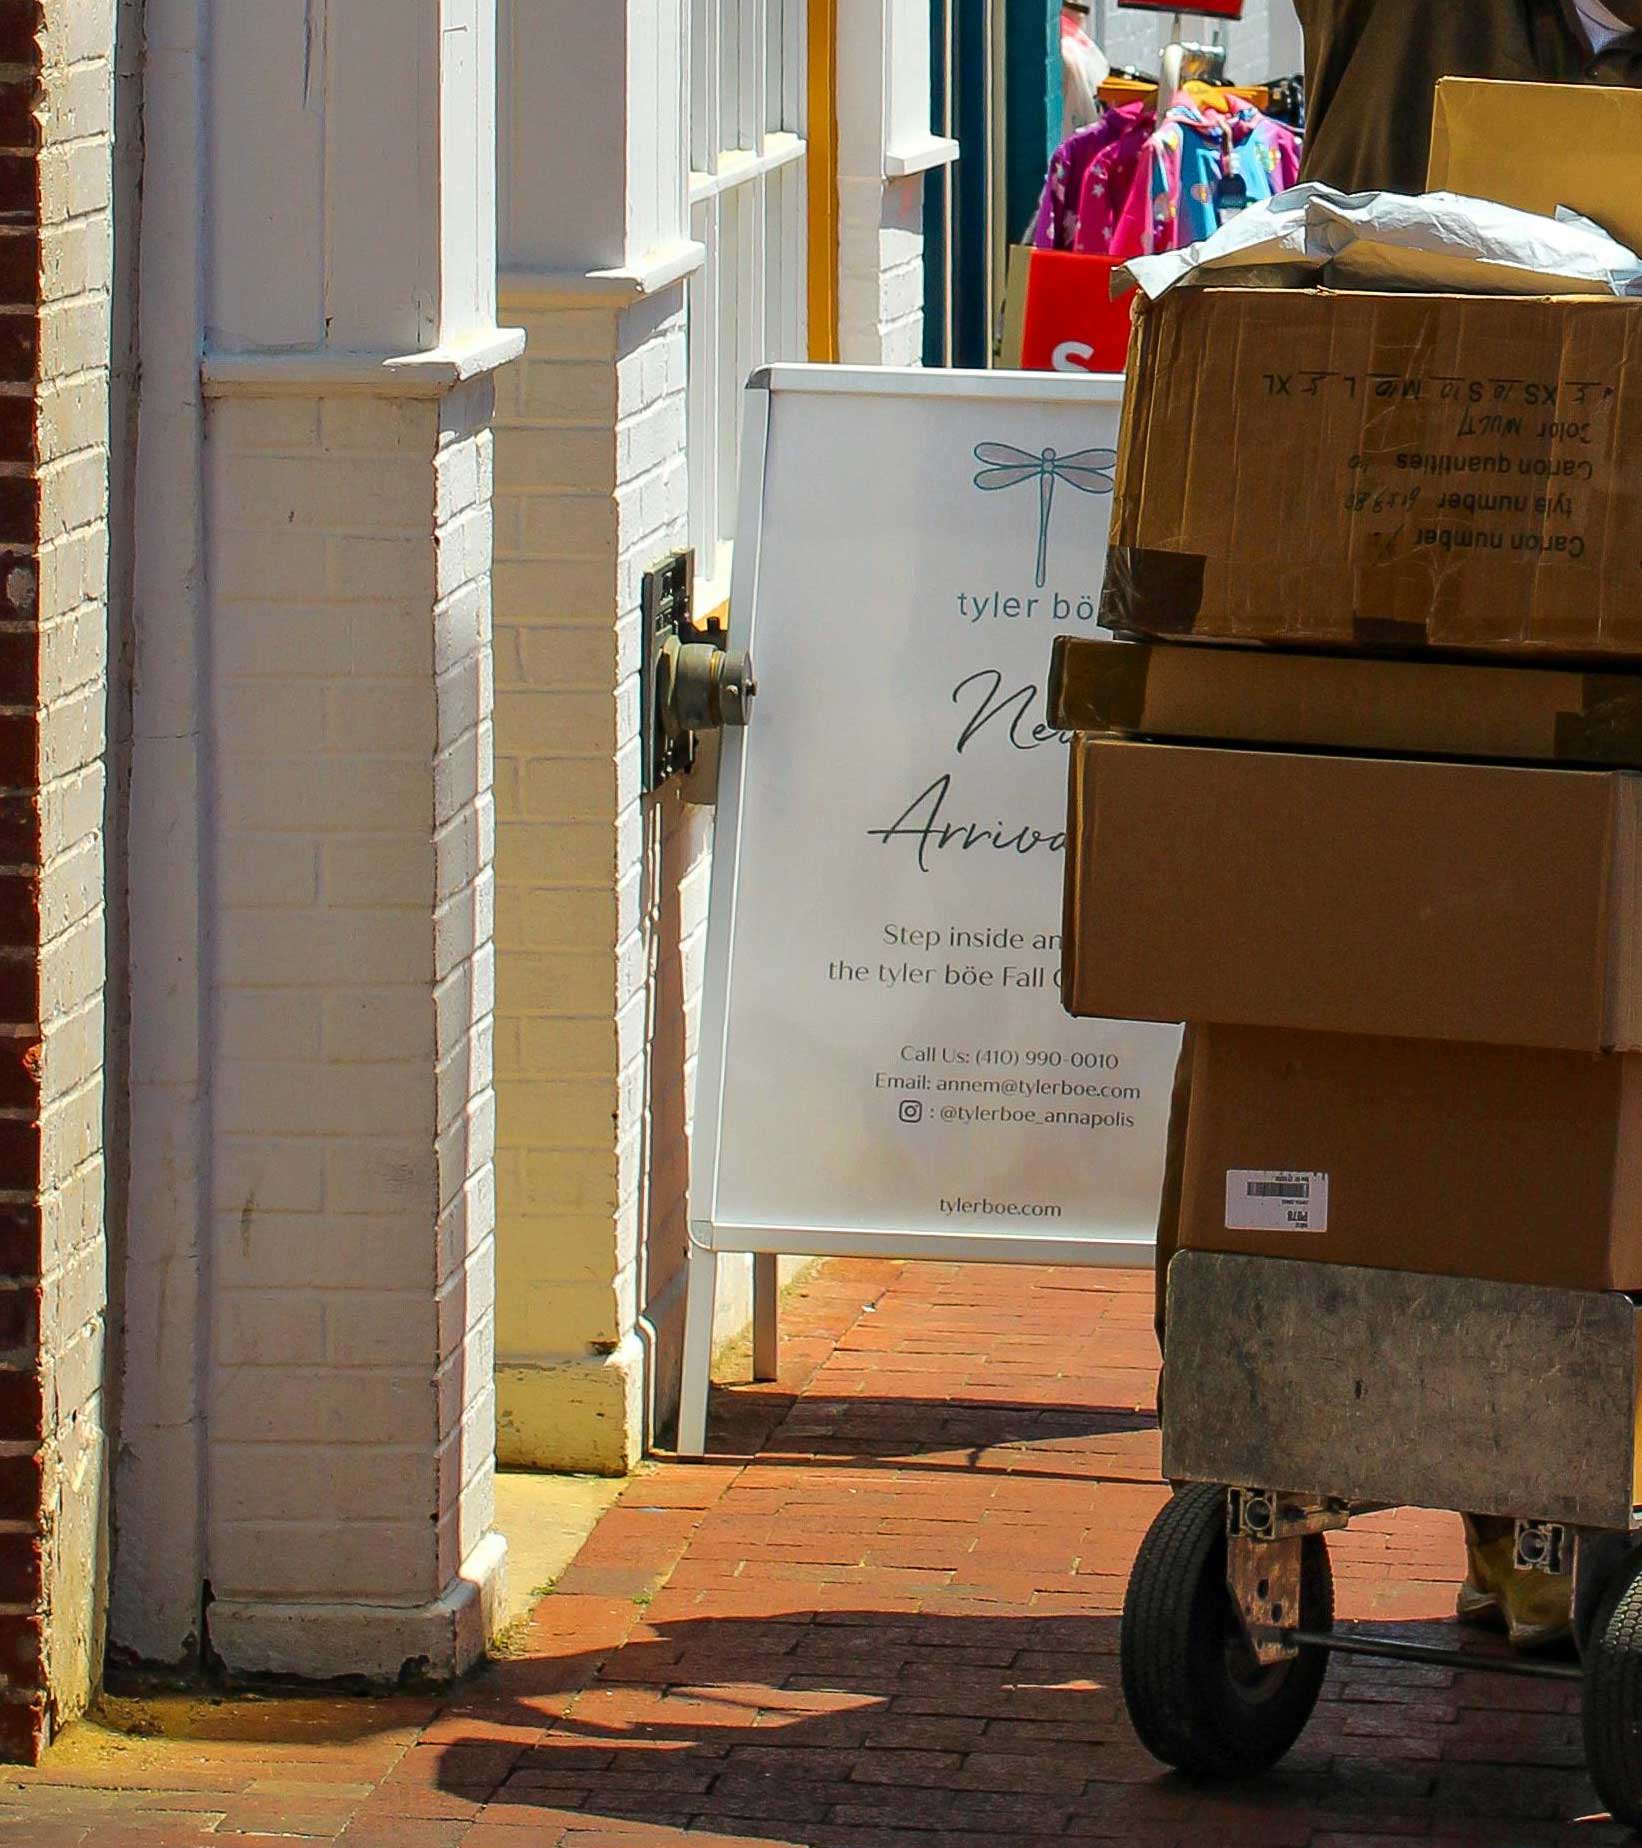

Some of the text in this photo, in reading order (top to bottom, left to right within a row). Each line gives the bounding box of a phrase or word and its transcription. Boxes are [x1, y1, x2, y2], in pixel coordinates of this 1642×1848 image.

[1262, 374, 1293, 396] XL
[1344, 377, 1356, 400] L
[1469, 382, 1483, 403] S
[1524, 384, 1558, 407] XS
[1394, 453, 1511, 479] quantities
[1436, 494, 1528, 517] number
[1413, 529, 1504, 556] number
[957, 591, 1039, 623] tyler
[952, 669, 1072, 753] Ne
[882, 923, 941, 951] Step
[949, 926, 1024, 950] inside
[828, 960, 869, 981] the
[878, 963, 936, 989] tyler
[944, 964, 993, 986] böe
[1003, 966, 1045, 988] Fall
[900, 1045, 1119, 1070] Call Us: (410) 990-0010
[874, 1072, 1141, 1100] Email: annem@tylerboe.com
[939, 1105, 1135, 1129] @tylerboe_annapolis
[940, 1197, 1062, 1217] tylerboe.com
